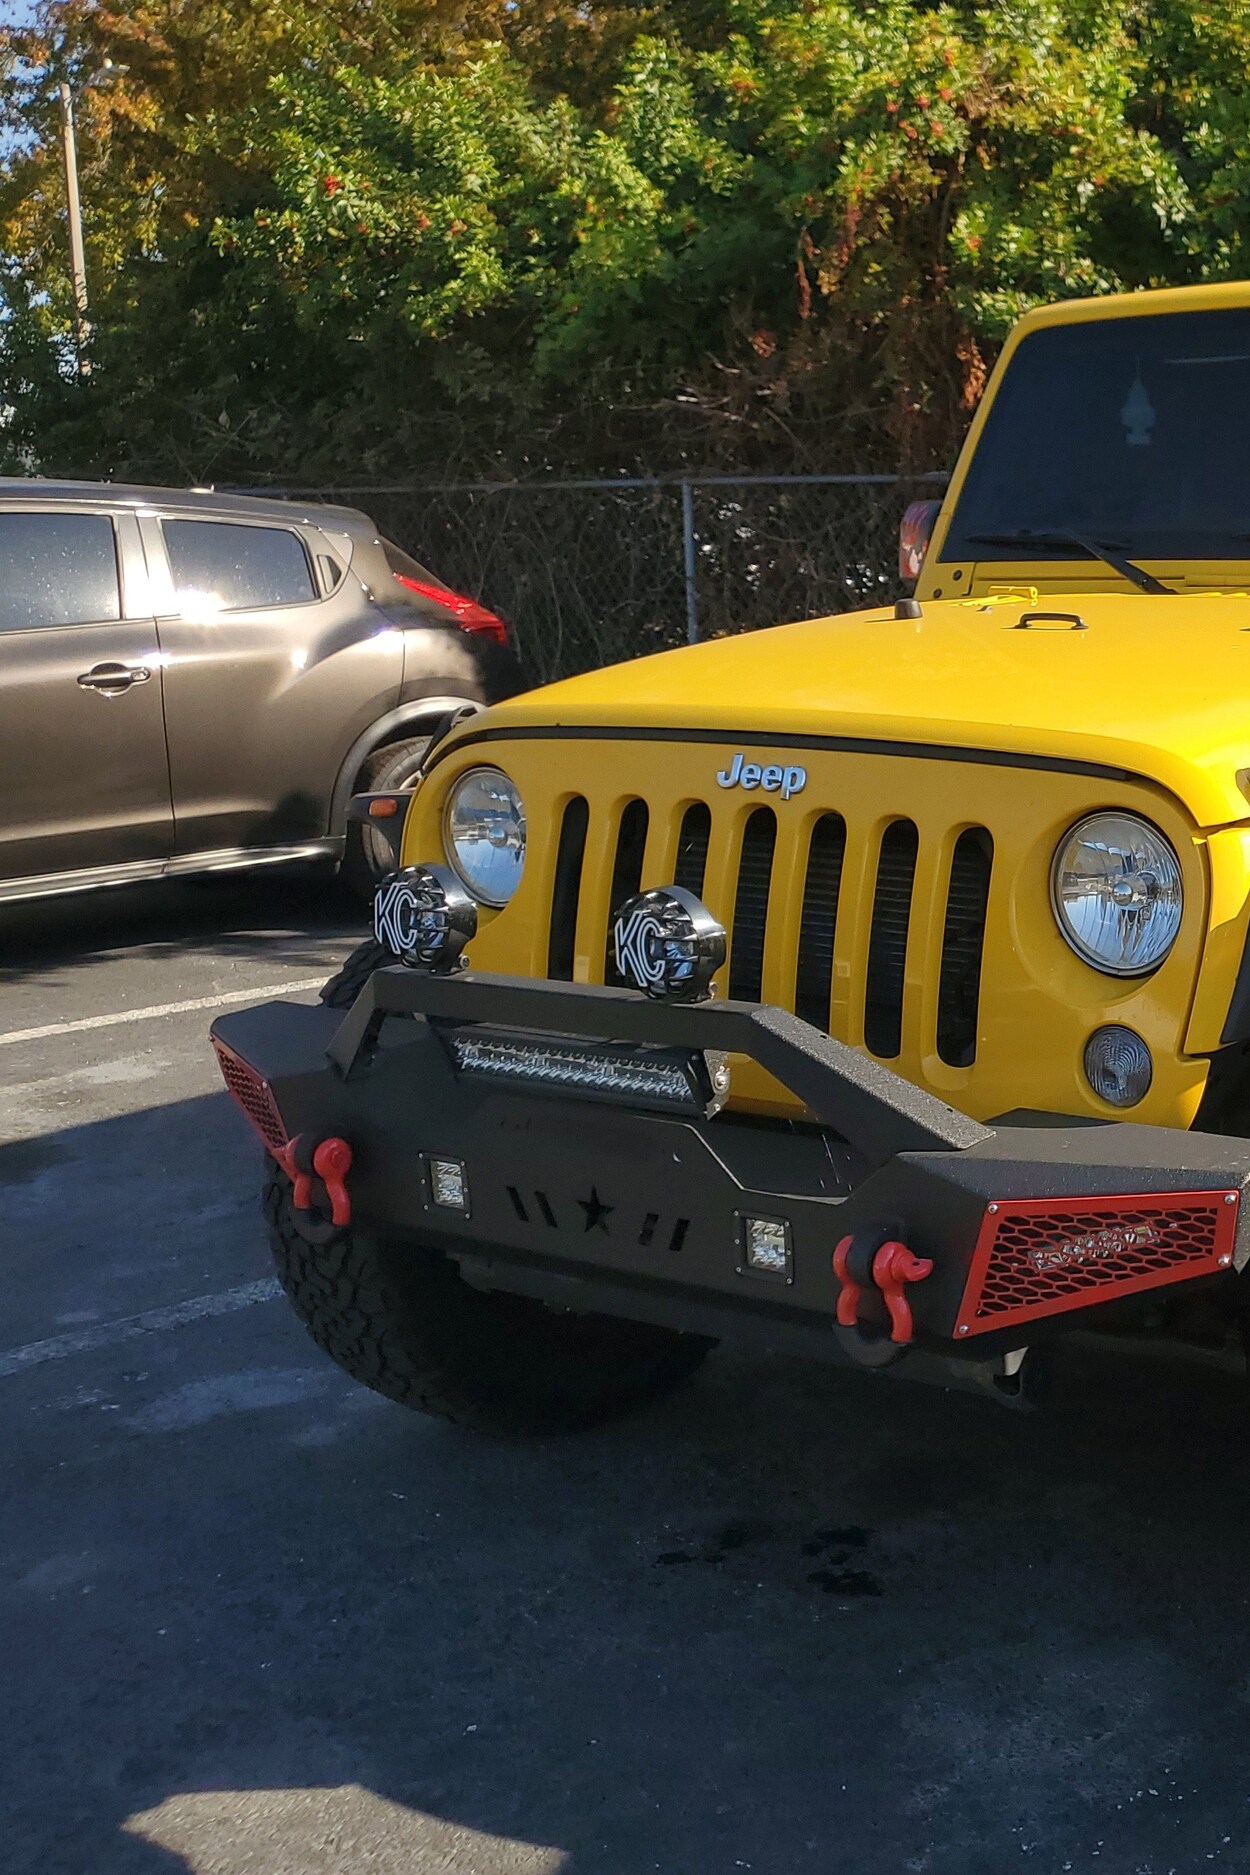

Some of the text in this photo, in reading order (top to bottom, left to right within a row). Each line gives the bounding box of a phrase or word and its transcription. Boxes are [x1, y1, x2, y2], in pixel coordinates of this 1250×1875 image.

[716, 752, 807, 800] Jeep
[374, 882, 418, 955] KC
[614, 910, 666, 986] KC
